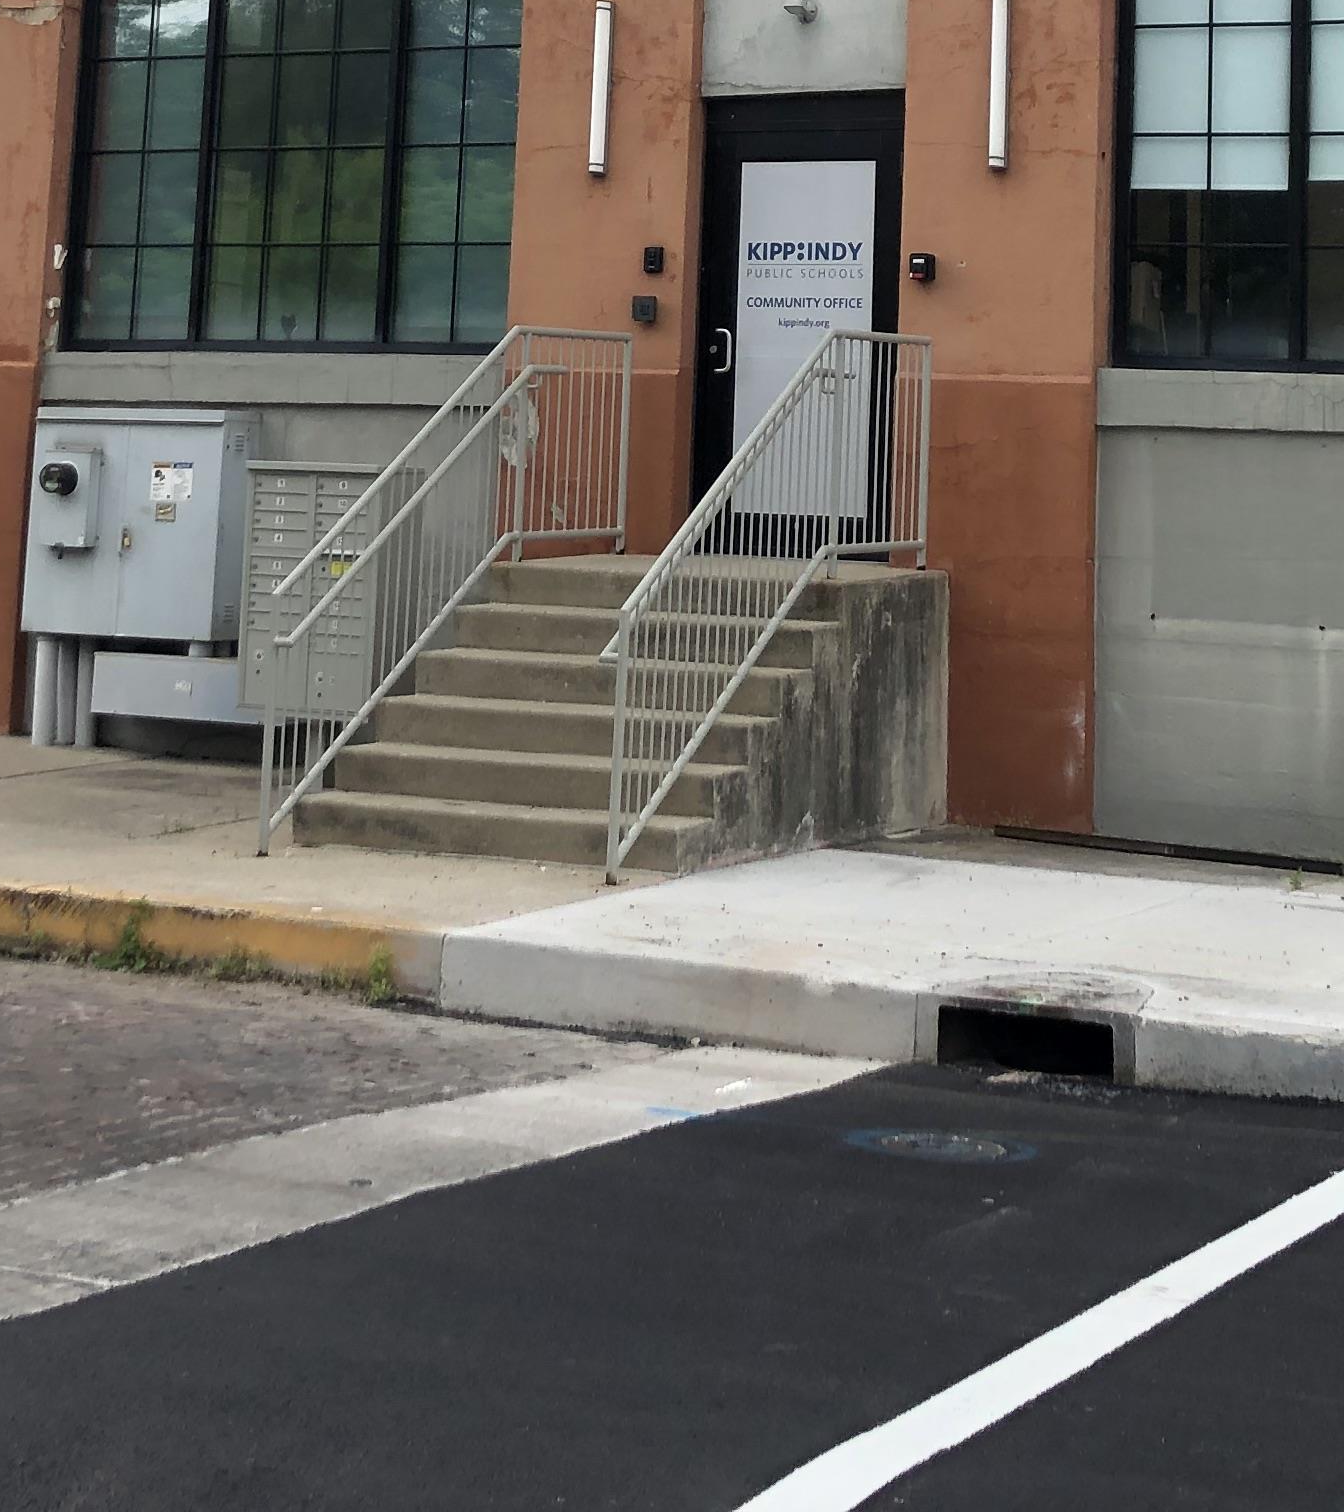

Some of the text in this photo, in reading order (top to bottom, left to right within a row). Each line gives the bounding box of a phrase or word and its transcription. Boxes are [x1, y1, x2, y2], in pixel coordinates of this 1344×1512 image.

[746, 268, 864, 279] PUBLIC SCHOOLS
[746, 296, 863, 309] COMMUNITY OFFICE
[778, 317, 830, 329] kippindy.org
